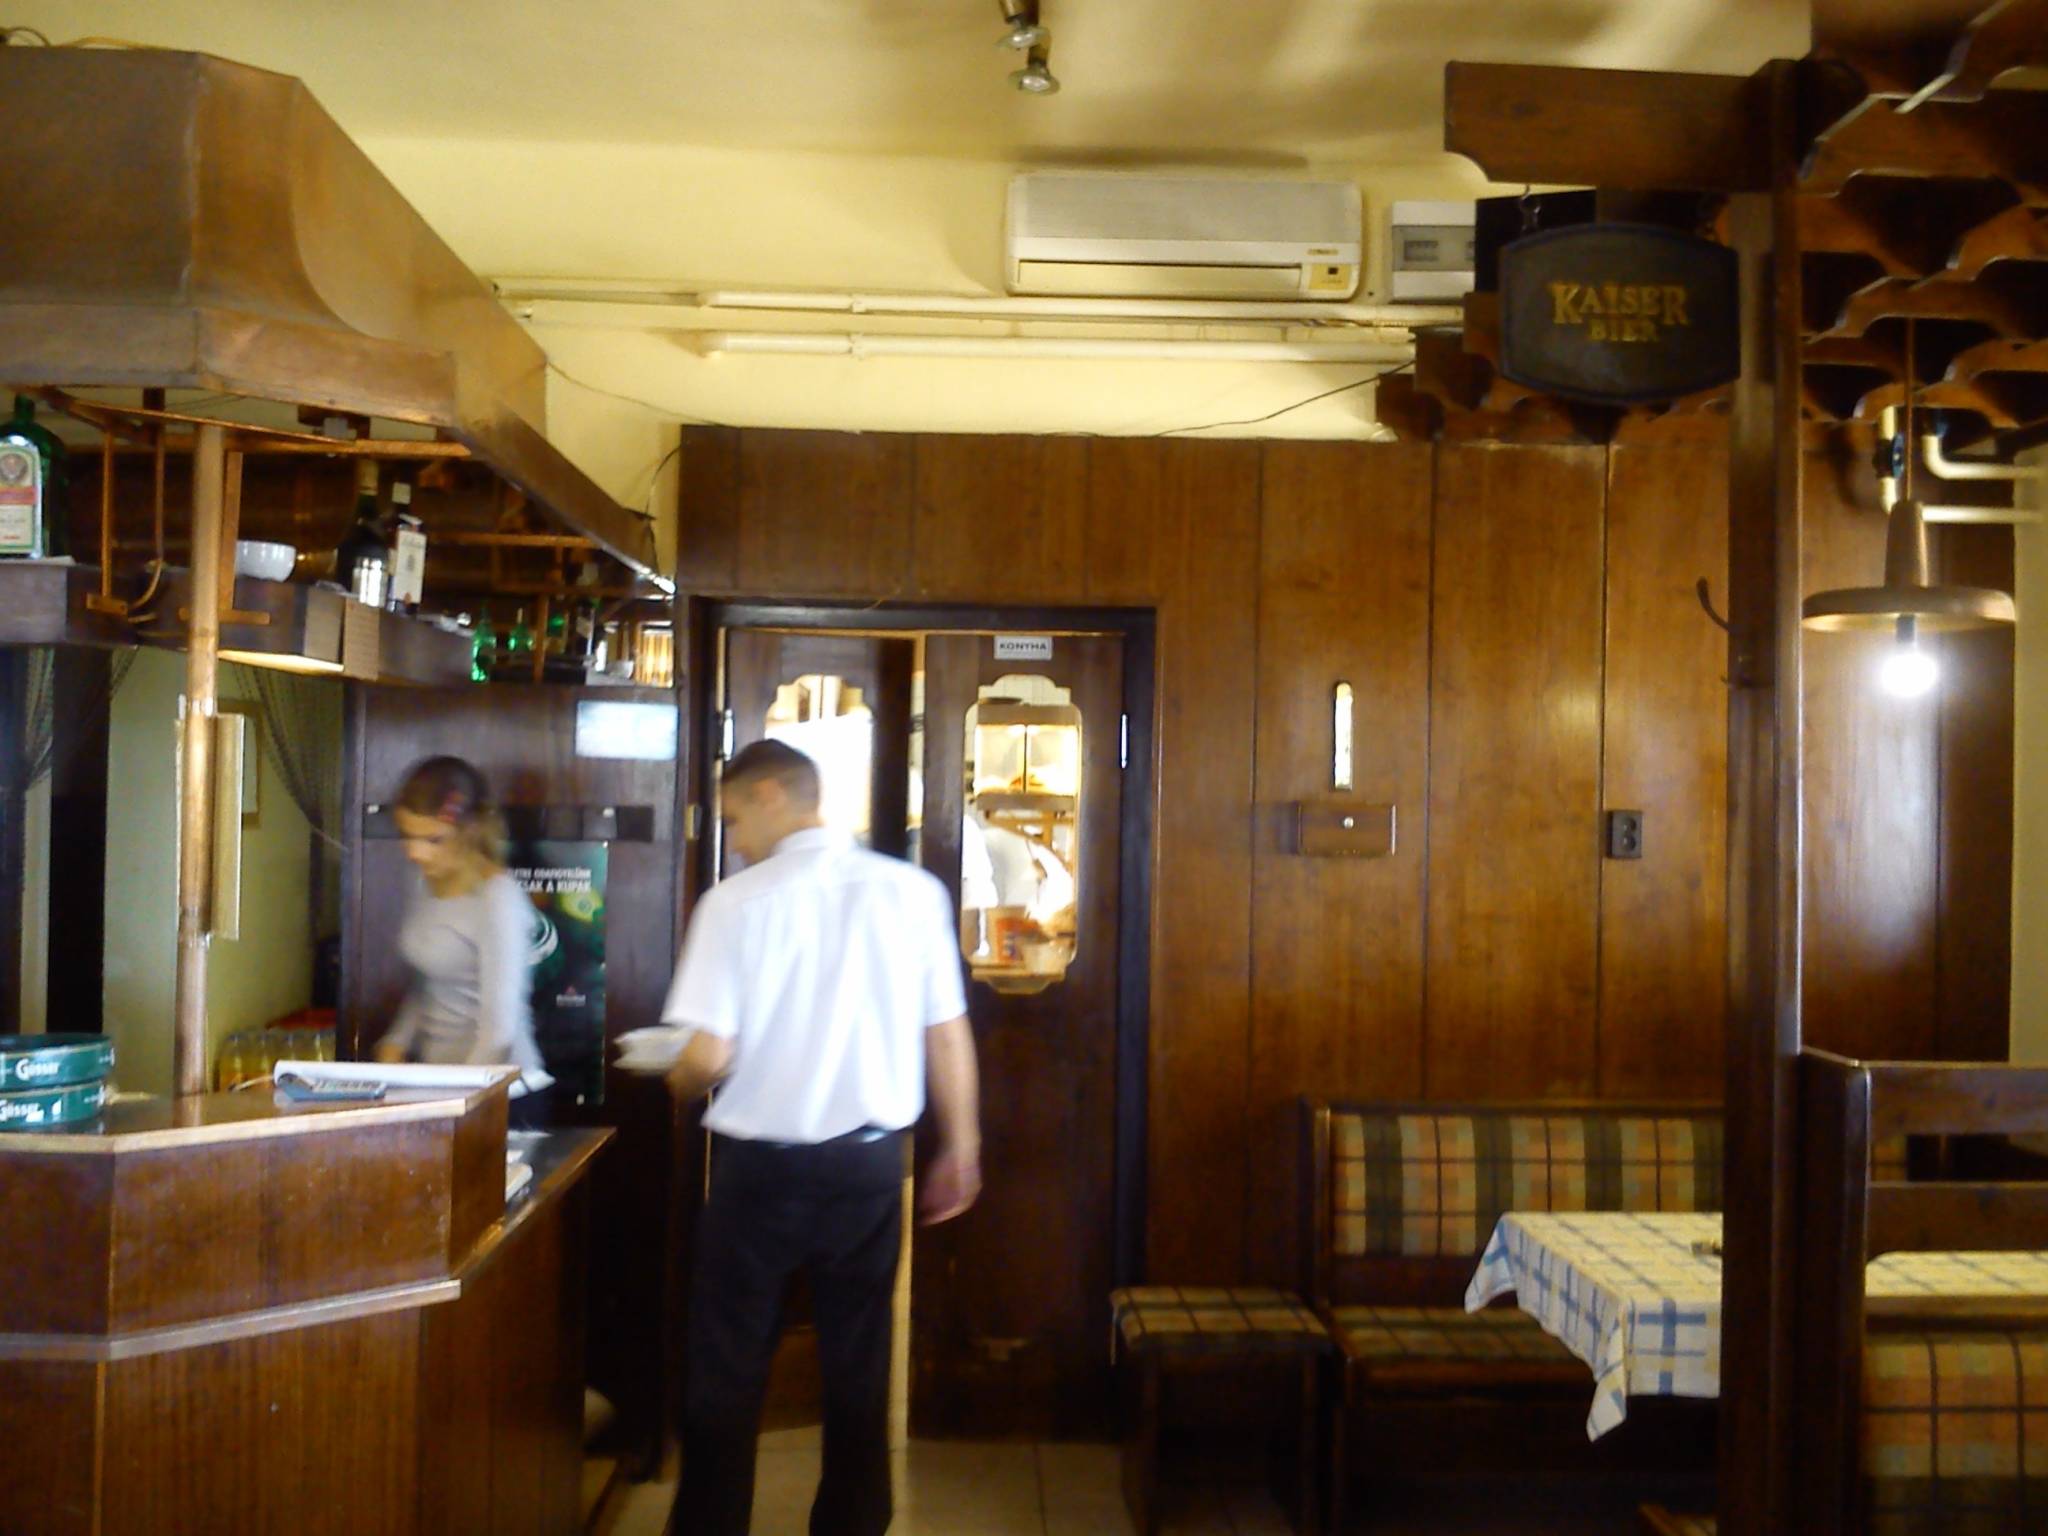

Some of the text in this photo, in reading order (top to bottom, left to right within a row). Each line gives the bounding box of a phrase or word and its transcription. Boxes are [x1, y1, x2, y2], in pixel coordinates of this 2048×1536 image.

[1551, 281, 1690, 325] KAISER
[1589, 318, 1659, 342] BIER
[999, 642, 1047, 650] KONYHA
